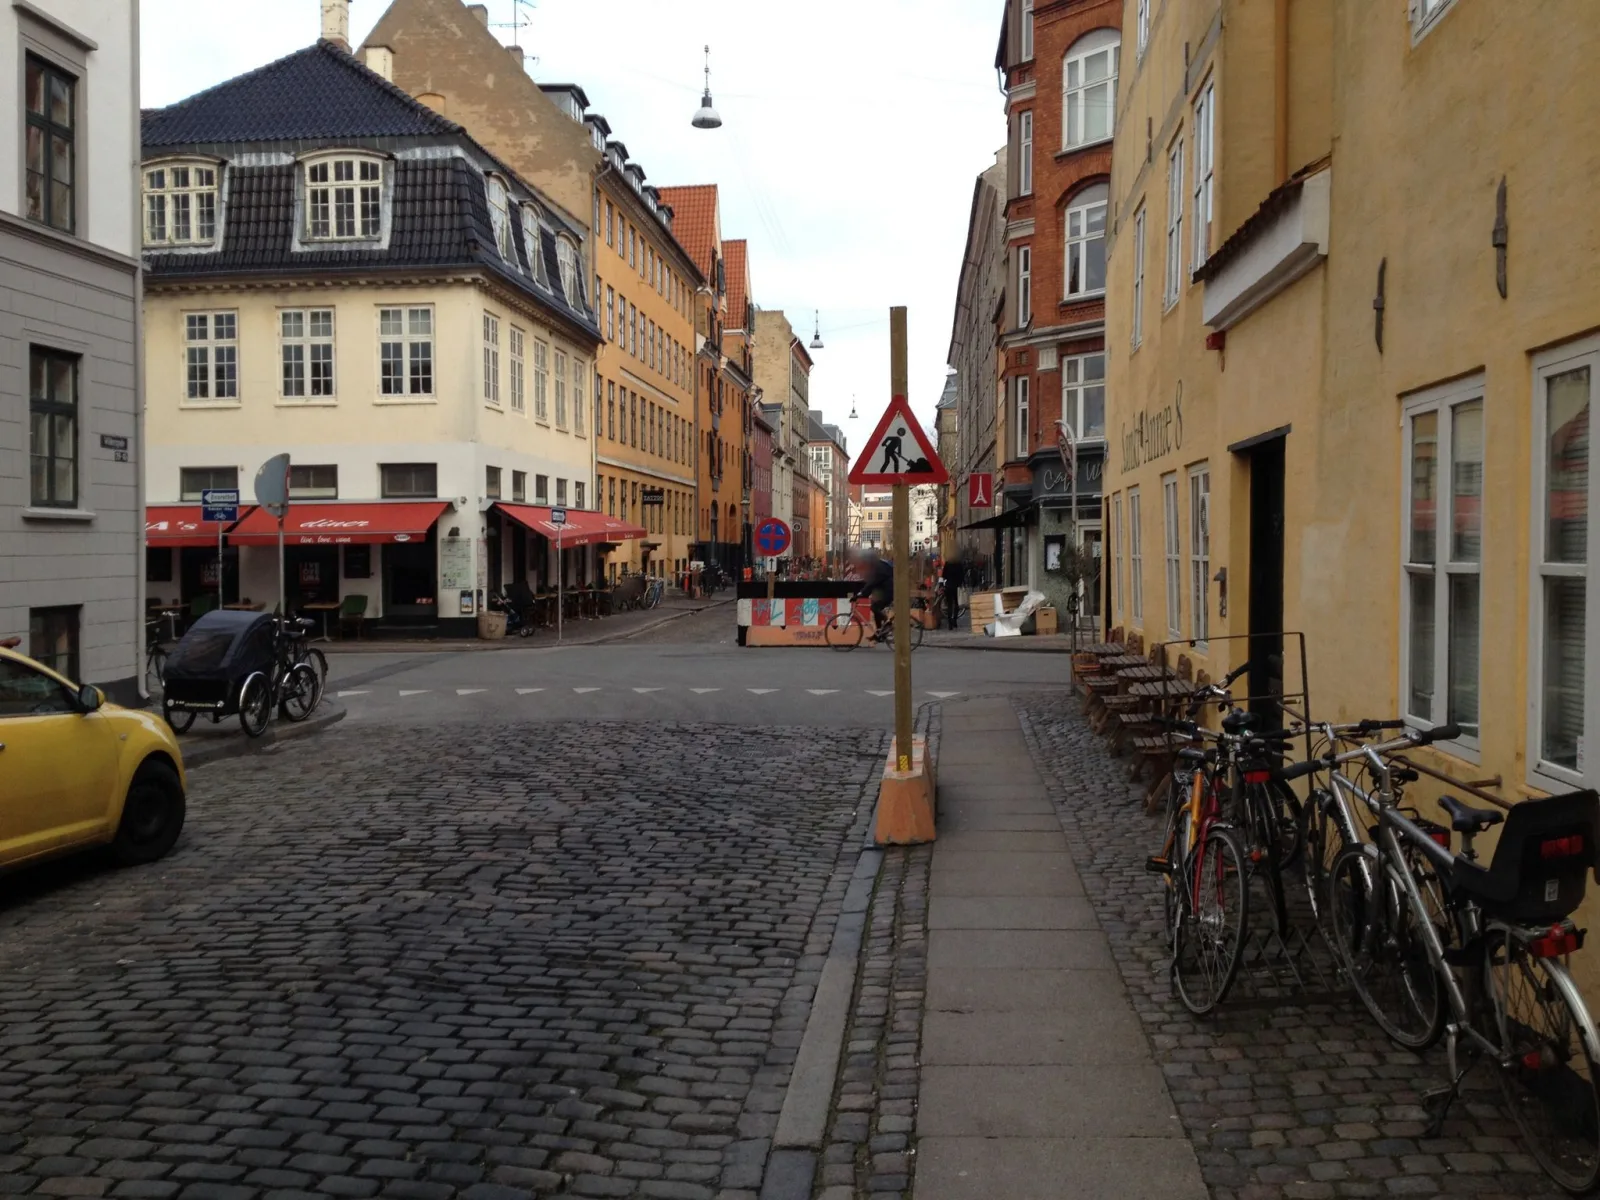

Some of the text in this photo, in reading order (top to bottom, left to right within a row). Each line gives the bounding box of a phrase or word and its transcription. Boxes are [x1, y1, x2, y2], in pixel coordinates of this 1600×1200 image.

[1175, 378, 1183, 451] 8
[146, 521, 198, 531] A's
[300, 518, 369, 528] diner
